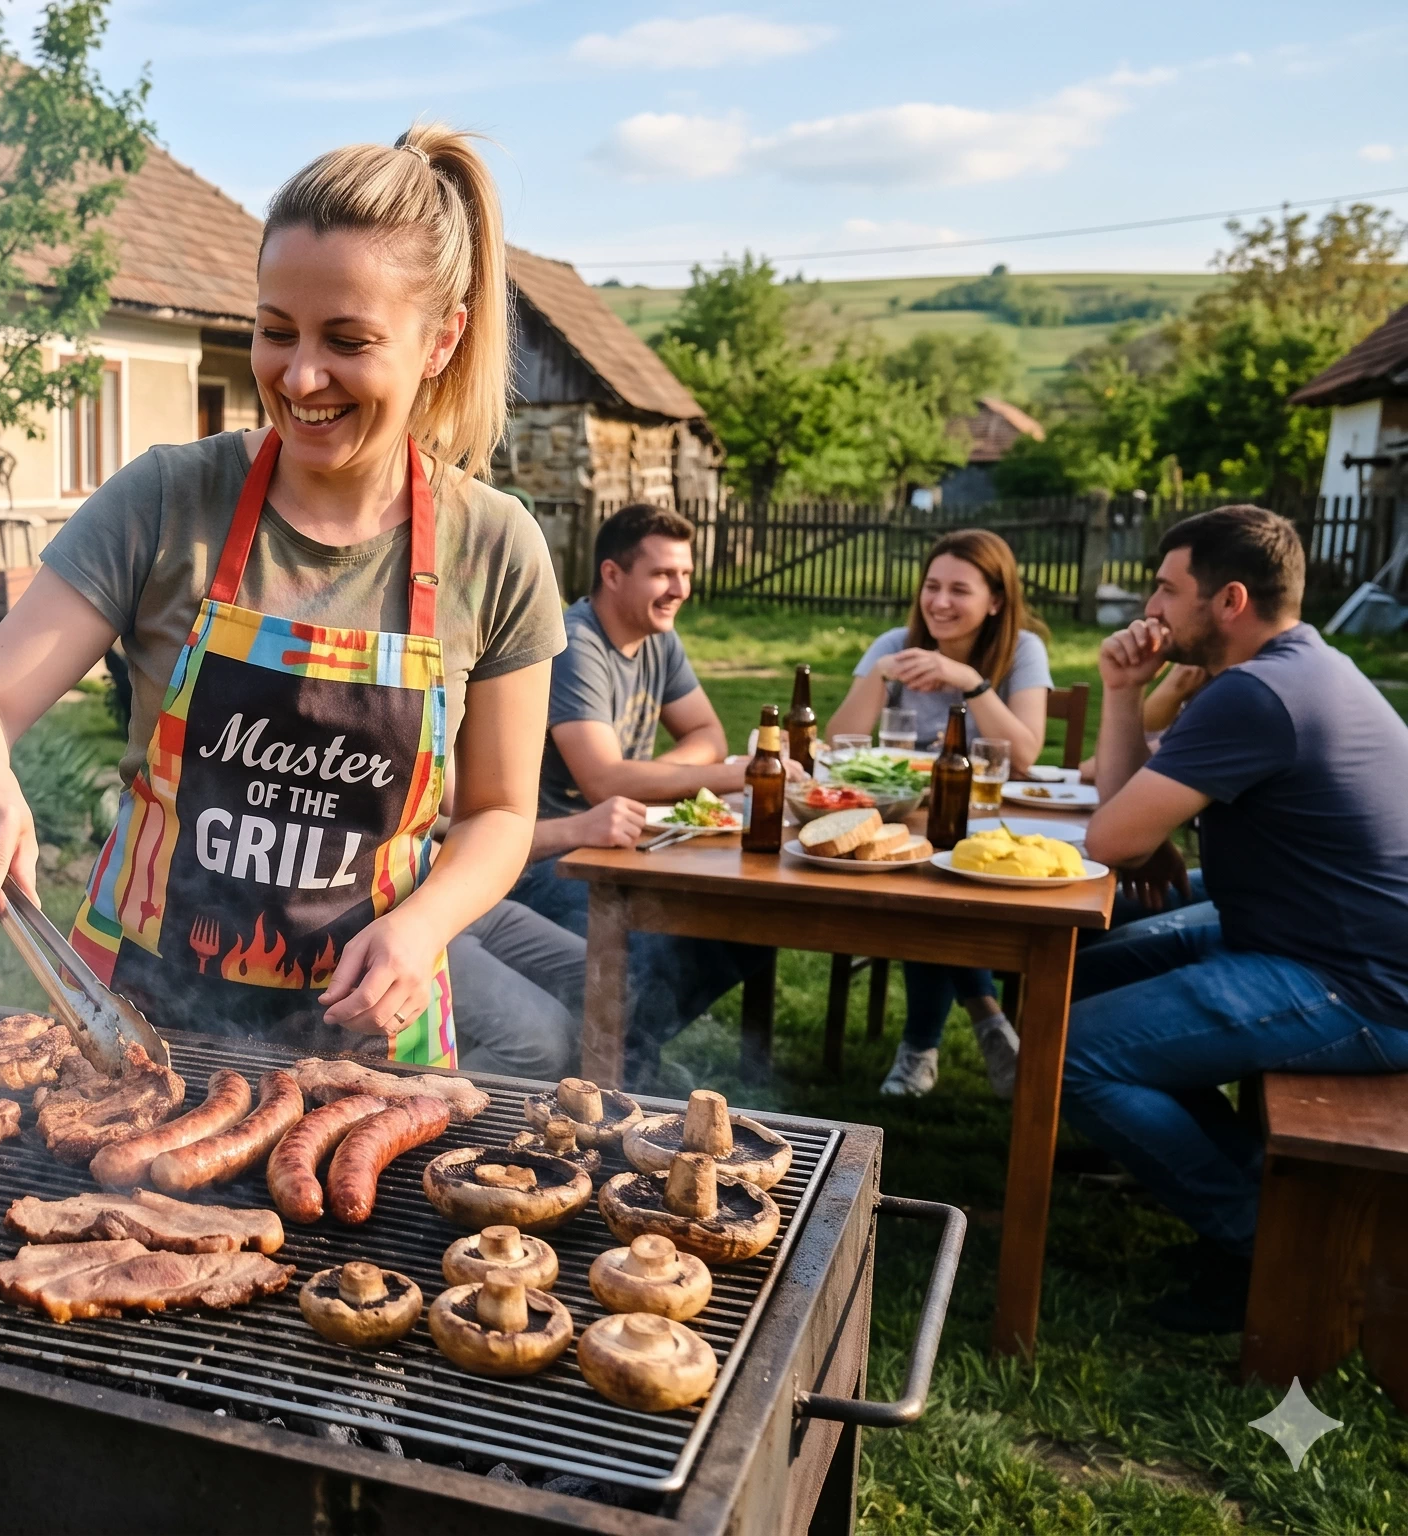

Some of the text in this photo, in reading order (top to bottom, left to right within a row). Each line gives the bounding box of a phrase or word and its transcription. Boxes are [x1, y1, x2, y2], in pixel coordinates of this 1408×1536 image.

[199, 712, 395, 788] Master
[246, 780, 340, 819] OF THE
[195, 807, 363, 890] GRILL
